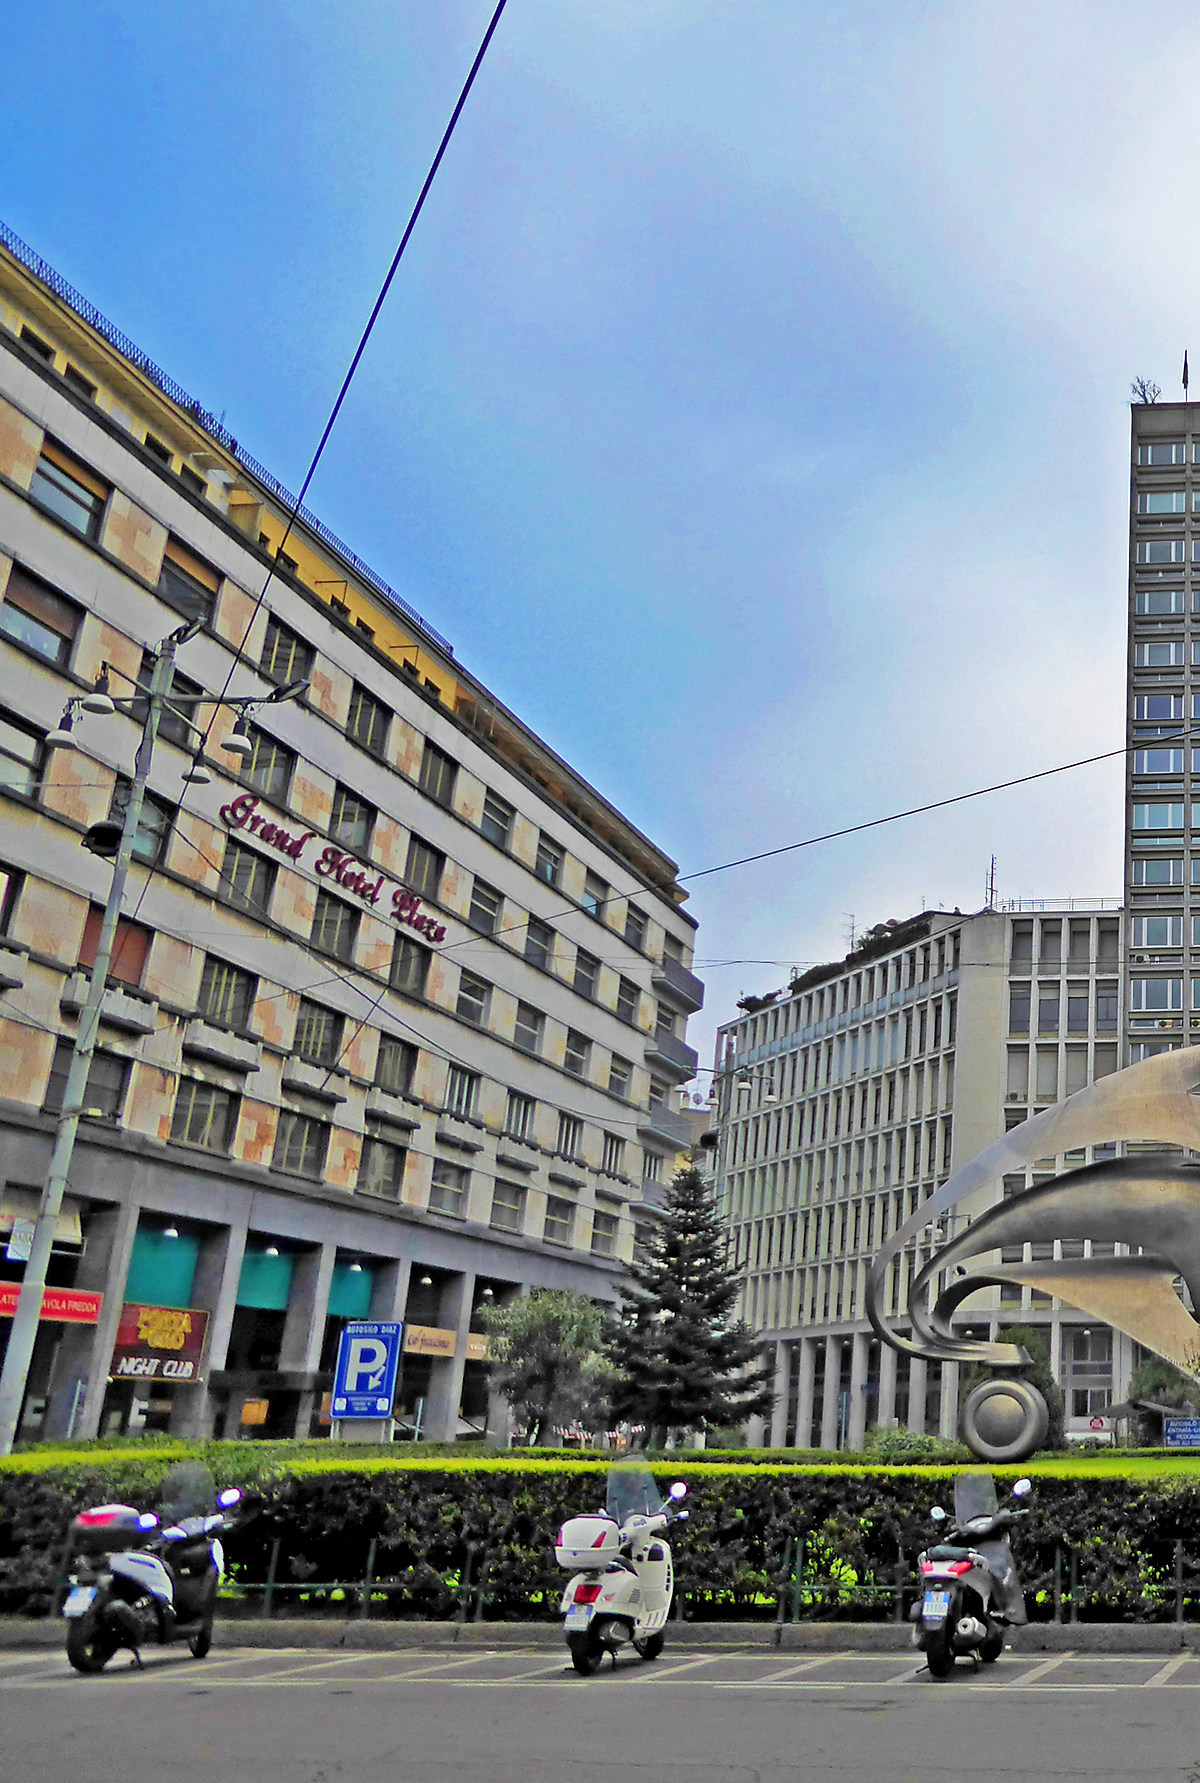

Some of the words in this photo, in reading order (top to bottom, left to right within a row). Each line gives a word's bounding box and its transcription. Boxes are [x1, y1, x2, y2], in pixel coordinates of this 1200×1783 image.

[219, 793, 317, 859] Grand
[315, 847, 386, 905] Hotel
[390, 888, 448, 943] Plaza
[42, 1299, 66, 1310] AVOLA
[117, 1357, 160, 1377] NIGHT
[163, 1360, 194, 1378] CLUB
[345, 1338, 388, 1391] P
